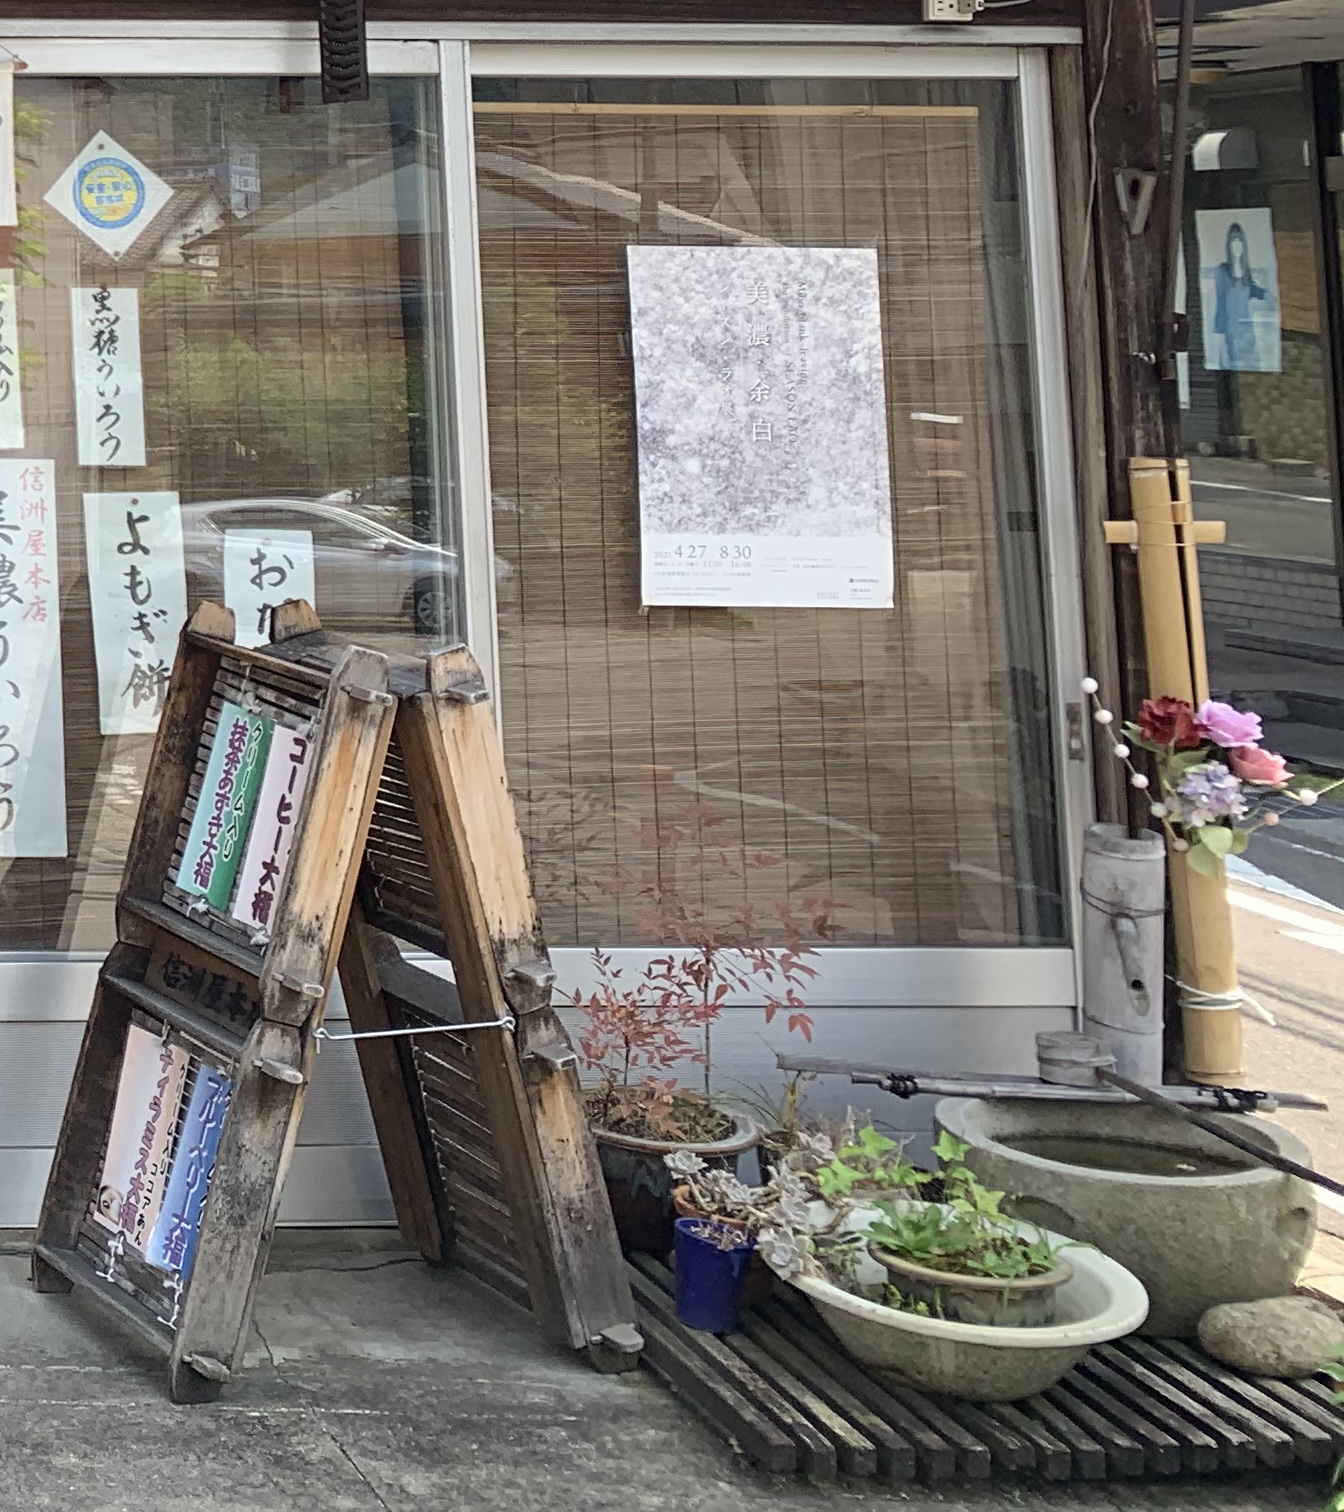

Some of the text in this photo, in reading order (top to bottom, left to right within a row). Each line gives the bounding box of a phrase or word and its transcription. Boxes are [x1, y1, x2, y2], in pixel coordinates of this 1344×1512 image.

[88, 288, 121, 462] 黒糖ういろう
[116, 510, 172, 717] よもぎ餅
[193, 715, 250, 890] 抹茶あずき大福
[222, 720, 264, 861] クリーム入り
[250, 736, 308, 926] コーヒー大福
[161, 1075, 222, 1268] ブルーベリー大福
